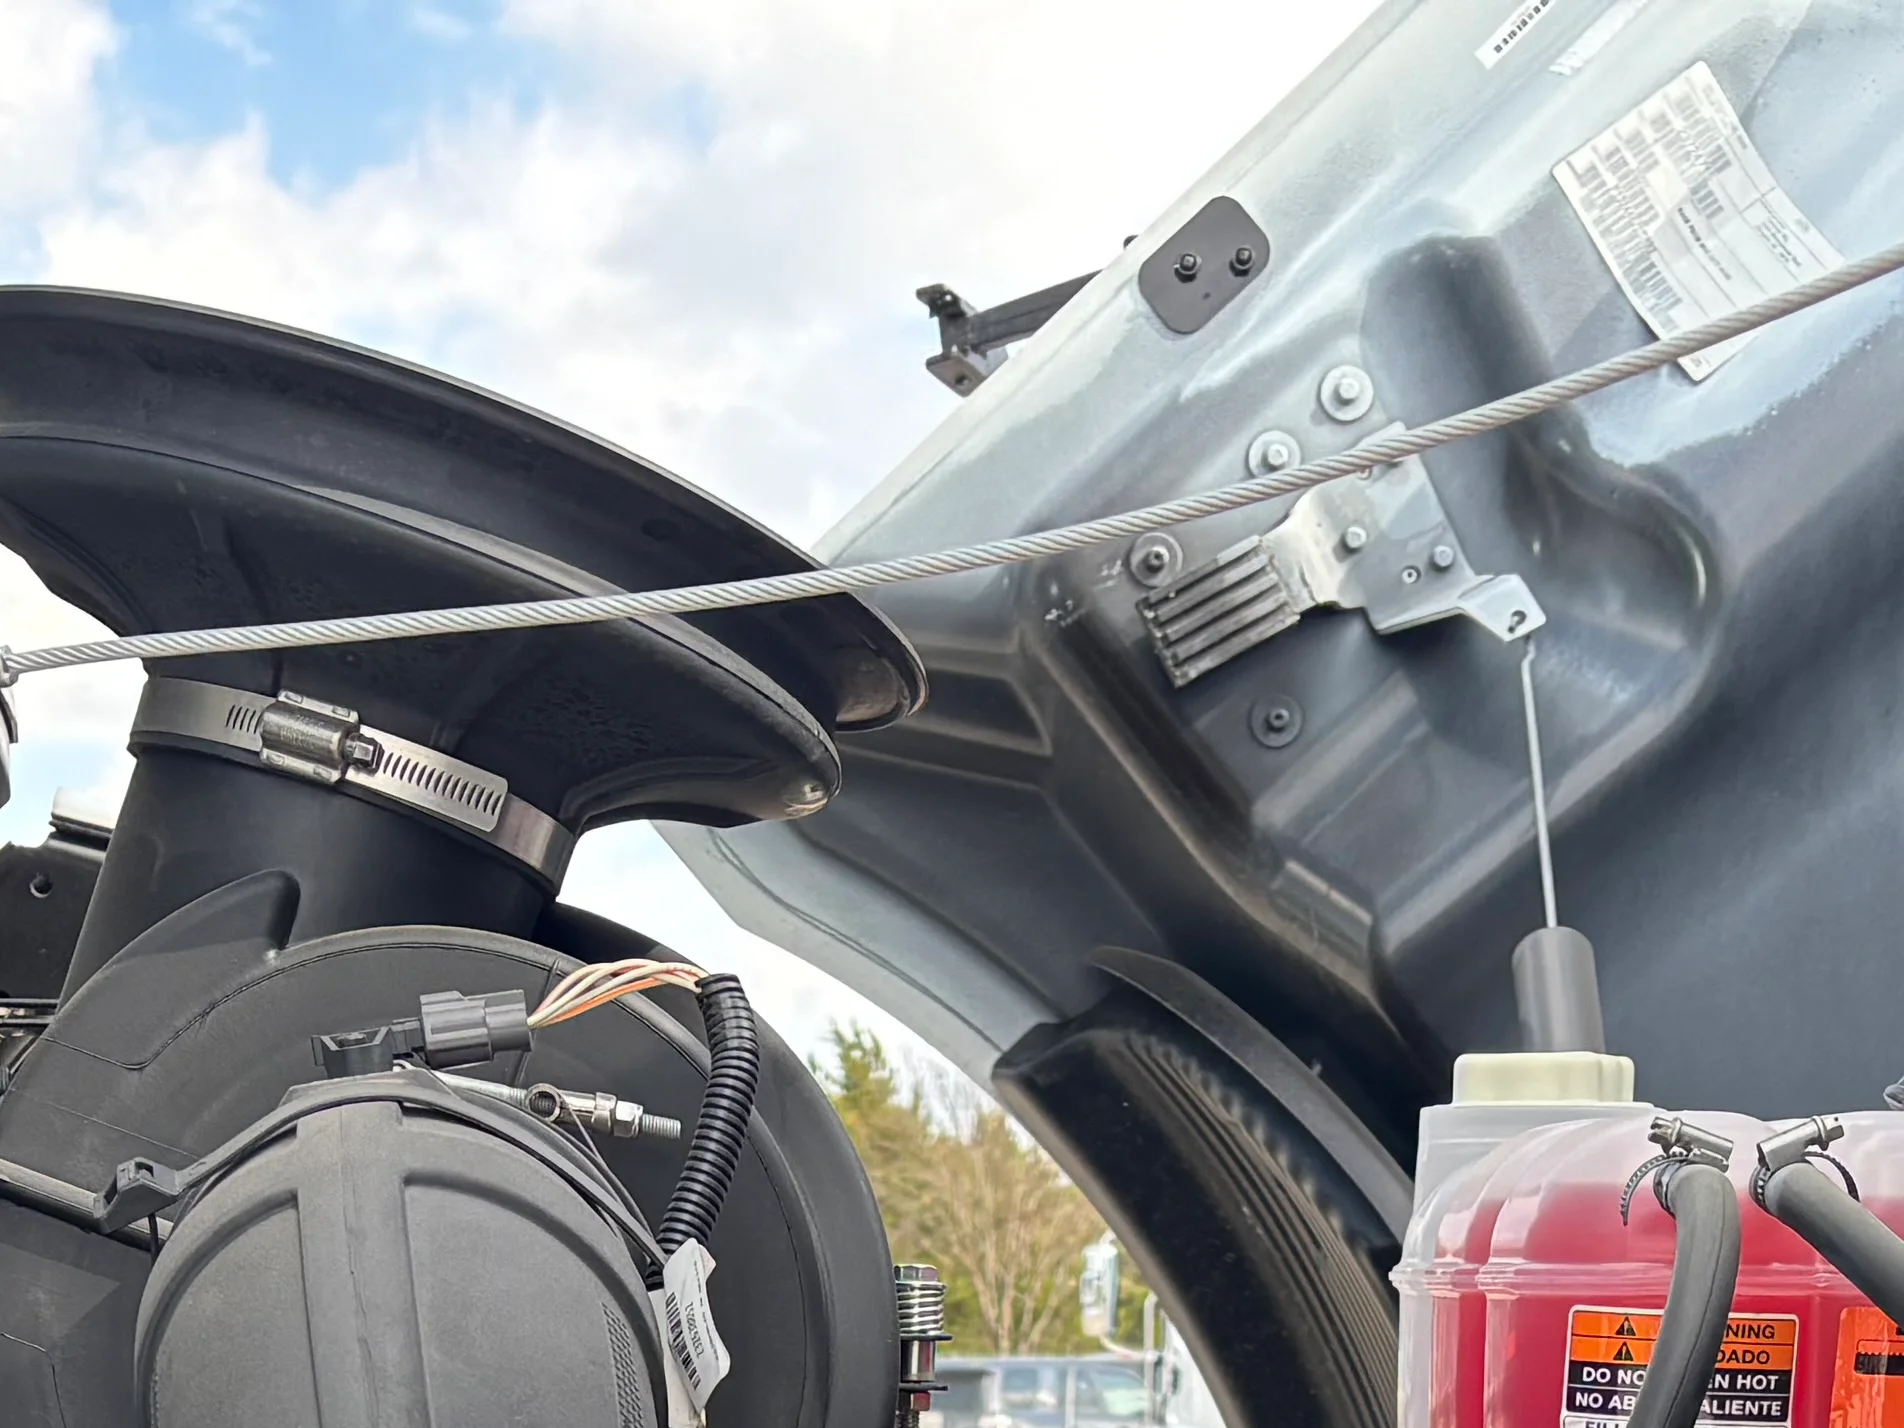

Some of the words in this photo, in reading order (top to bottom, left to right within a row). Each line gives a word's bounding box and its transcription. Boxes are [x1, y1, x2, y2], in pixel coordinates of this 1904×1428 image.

[1726, 1323, 1775, 1340] NING
[1716, 1350, 1770, 1365] DADO
[1582, 1367, 1611, 1383] DO
[1617, 1370, 1646, 1386] NO
[1737, 1375, 1778, 1390] HOT
[1575, 1393, 1603, 1407] NO
[1608, 1395, 1636, 1410] AB
[1700, 1399, 1782, 1416] ALIENTE
